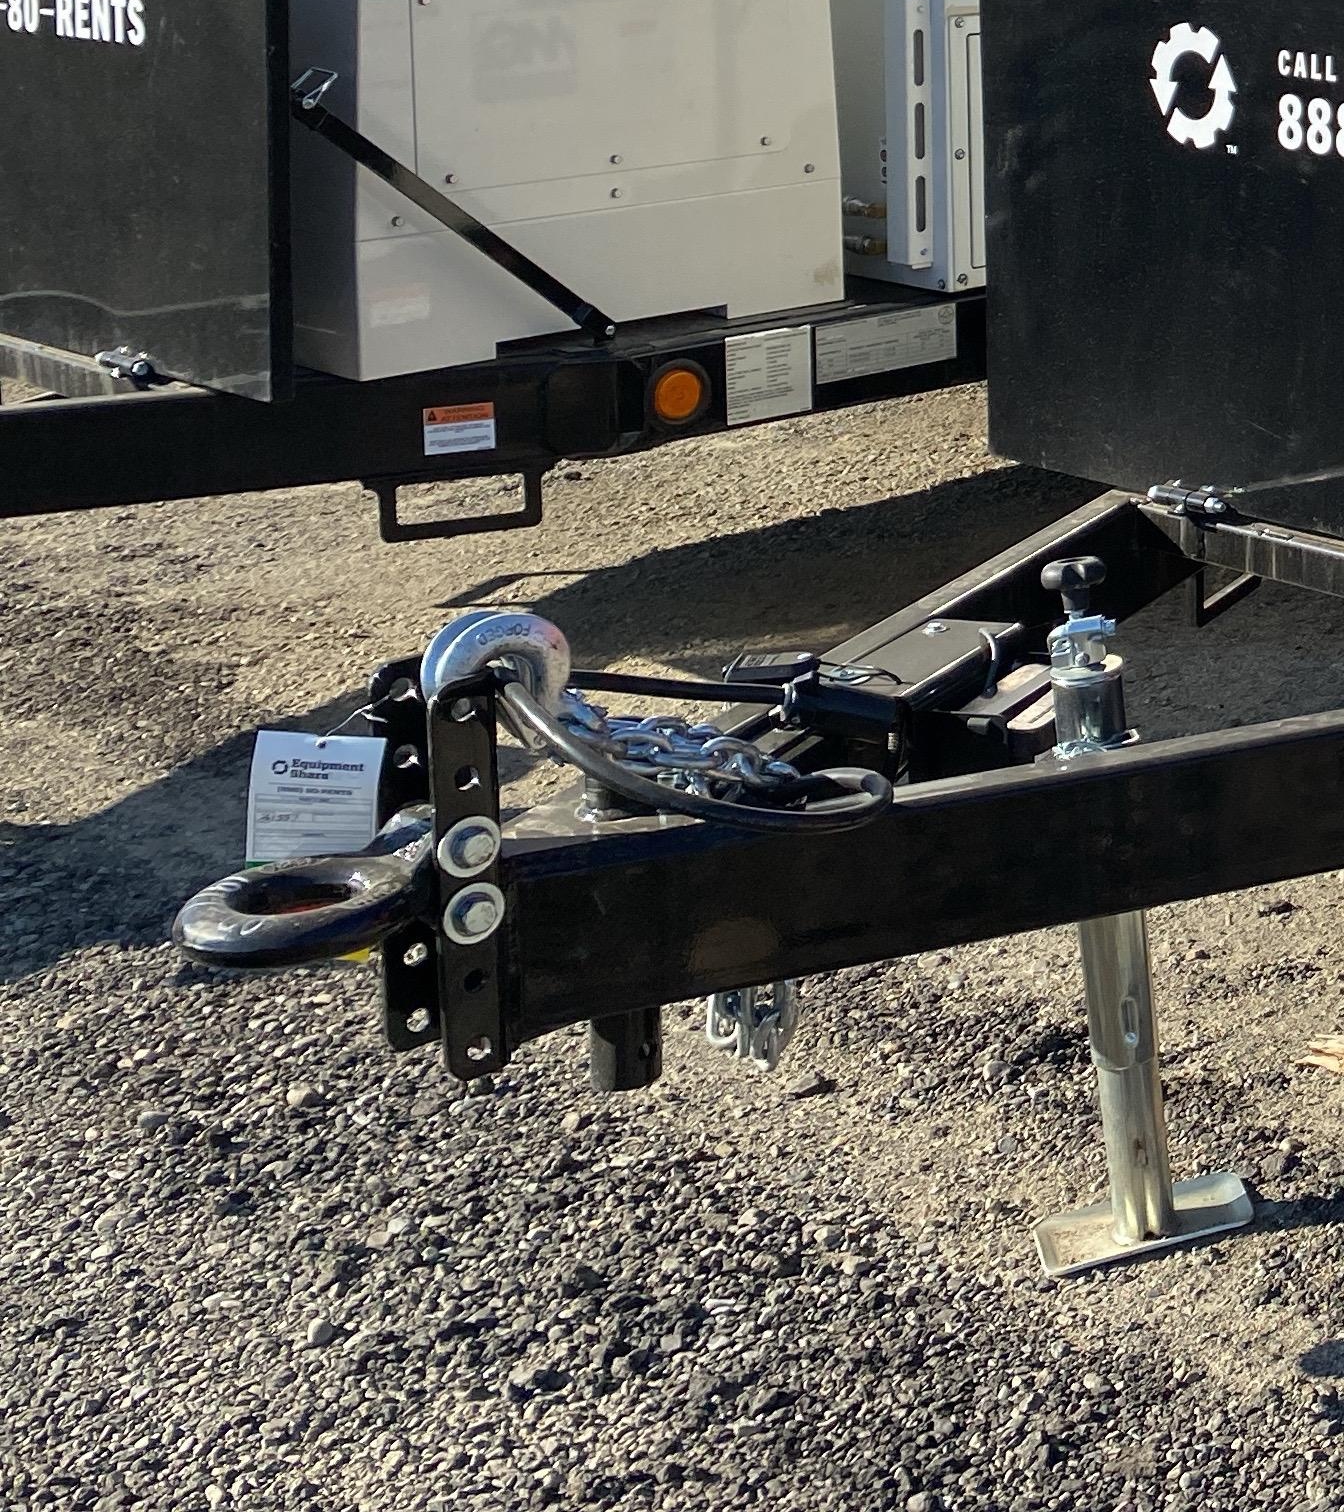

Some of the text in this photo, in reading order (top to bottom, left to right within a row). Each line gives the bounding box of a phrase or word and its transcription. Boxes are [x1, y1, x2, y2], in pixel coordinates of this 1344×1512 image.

[1277, 49, 1338, 82] CALL
[291, 758, 365, 772] Equipment
[290, 769, 329, 780] Share
